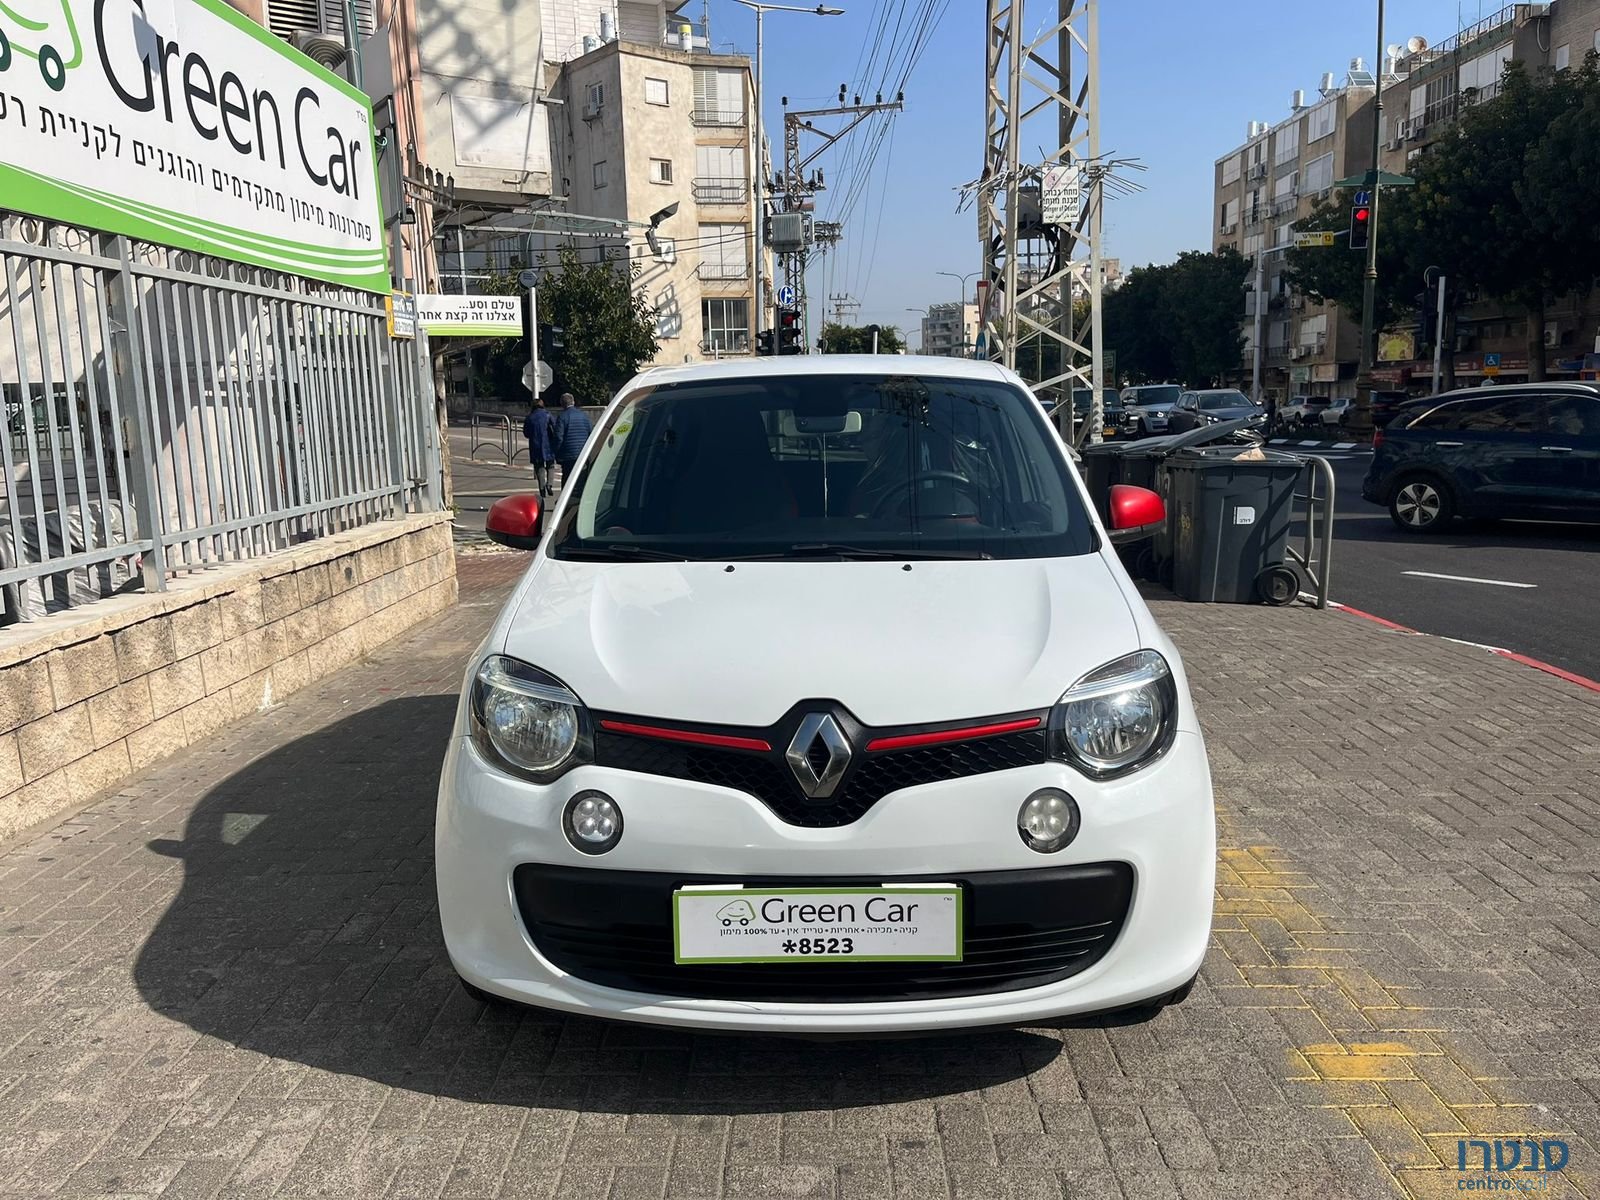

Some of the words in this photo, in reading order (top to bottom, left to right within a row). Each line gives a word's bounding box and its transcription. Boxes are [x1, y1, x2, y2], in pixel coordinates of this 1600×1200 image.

[93, 0, 286, 170] Green
[294, 87, 361, 200] Car
[39, 105, 121, 160] לקניית
[133, 140, 204, 186] והוגנים
[212, 168, 285, 212] מתקדמים
[290, 197, 325, 226] מימון
[329, 211, 372, 241] פתרונות
[491, 299, 515, 309] שלם
[446, 311, 468, 322] קצת
[471, 311, 483, 320] זה
[487, 311, 515, 321] אצלנו
[761, 897, 856, 923] Green
[864, 897, 918, 923] Car
[720, 927, 742, 936] מימון
[786, 927, 799, 935] אין
[830, 926, 860, 934] אחריות
[866, 926, 892, 934] מכירה
[899, 926, 918, 934] קניה
